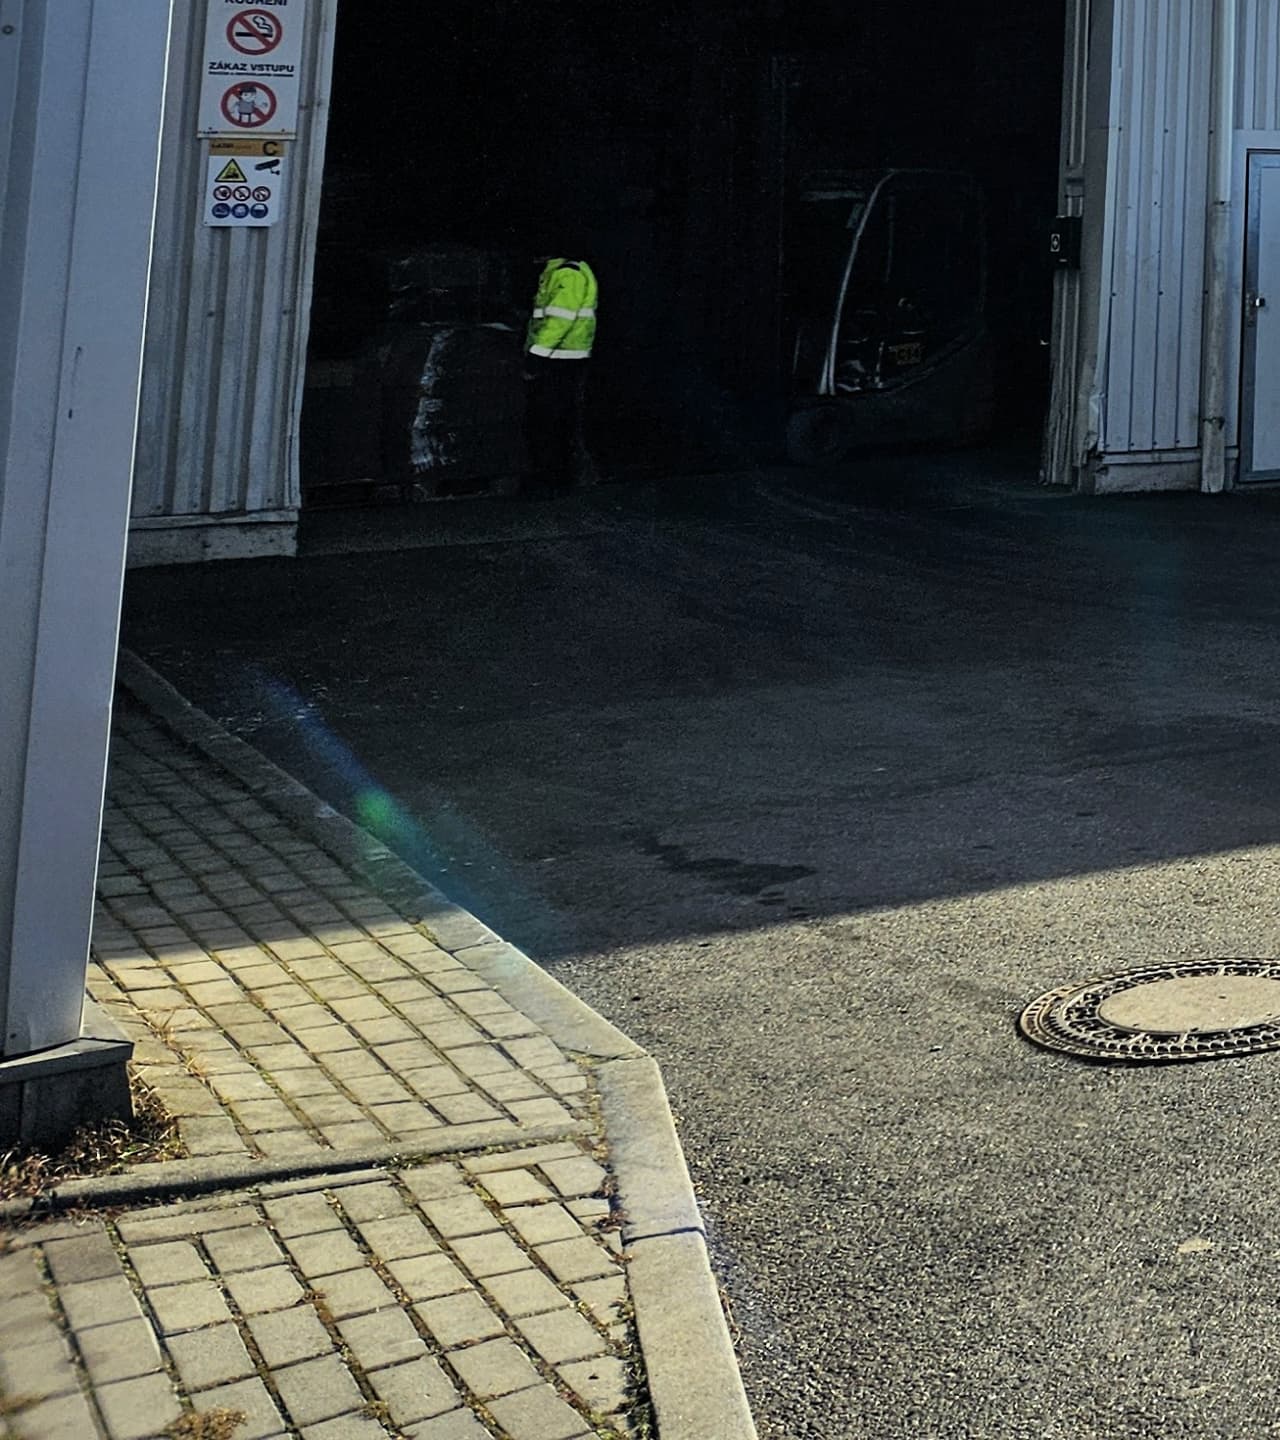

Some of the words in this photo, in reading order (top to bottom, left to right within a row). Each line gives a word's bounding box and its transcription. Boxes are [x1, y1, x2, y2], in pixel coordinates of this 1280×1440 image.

[209, 61, 248, 71] ZÁKAZ
[250, 63, 294, 73] VSTUPU
[263, 141, 278, 156] C
